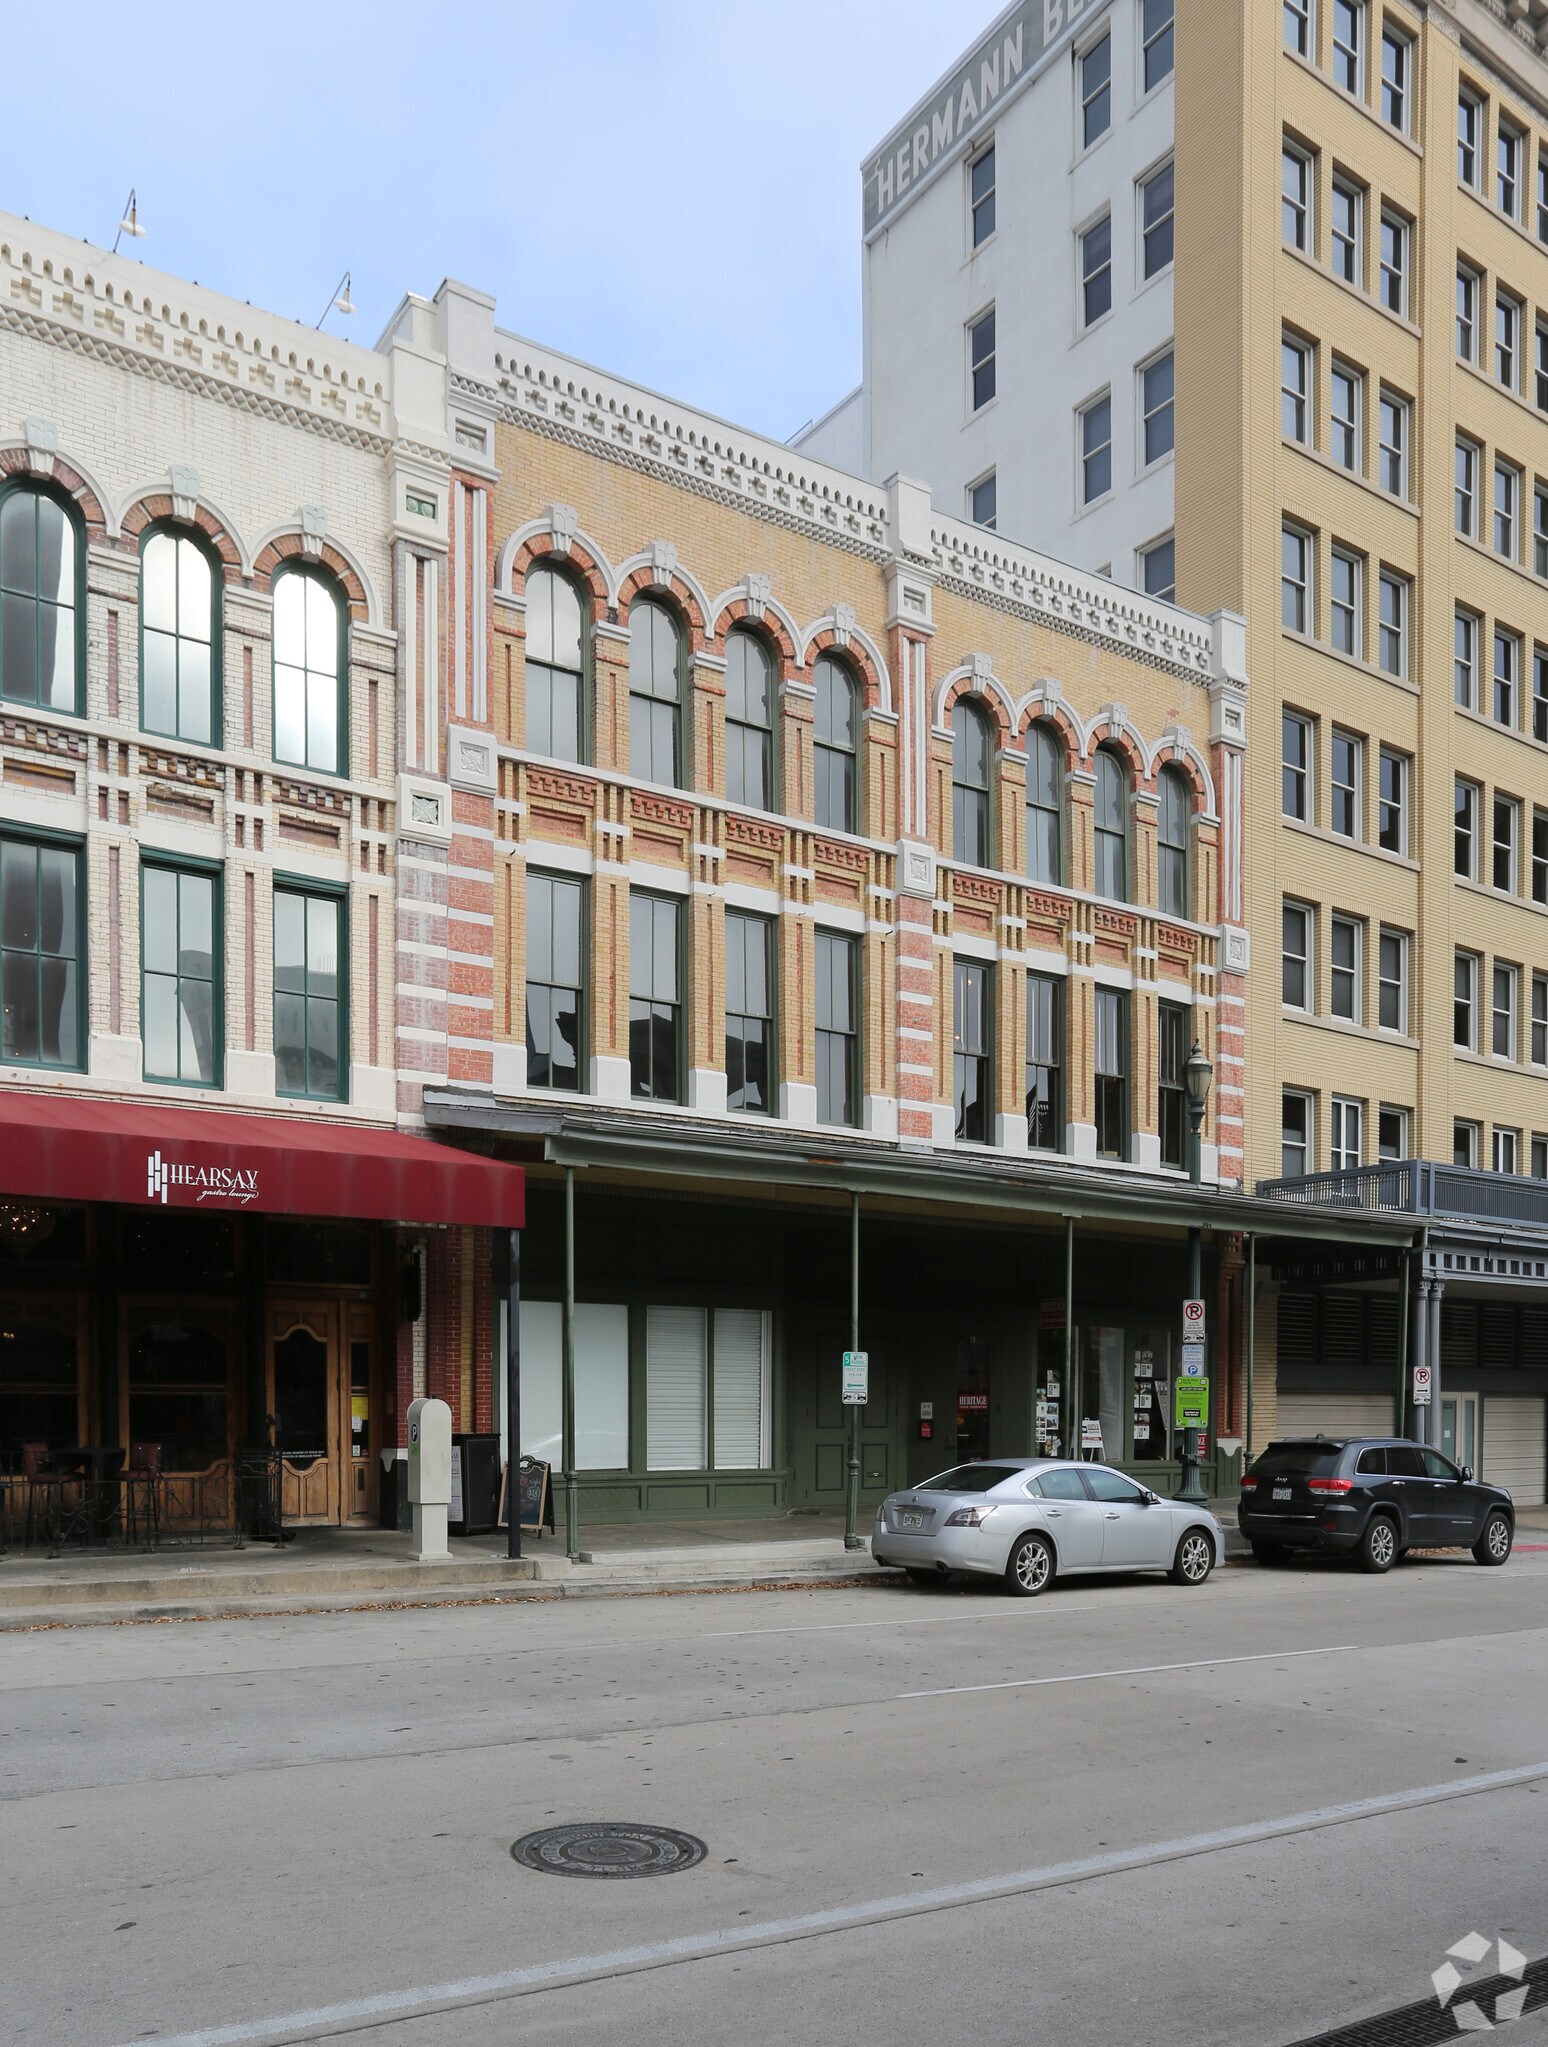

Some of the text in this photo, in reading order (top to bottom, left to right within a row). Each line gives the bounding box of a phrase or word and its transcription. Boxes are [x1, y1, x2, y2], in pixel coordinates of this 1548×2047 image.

[875, 0, 1091, 215] HERMANN BL
[170, 1164, 259, 1189] HEARSAY
[196, 1186, 260, 1204] gastro lounge
[959, 1396, 988, 1406] HERITAGE
